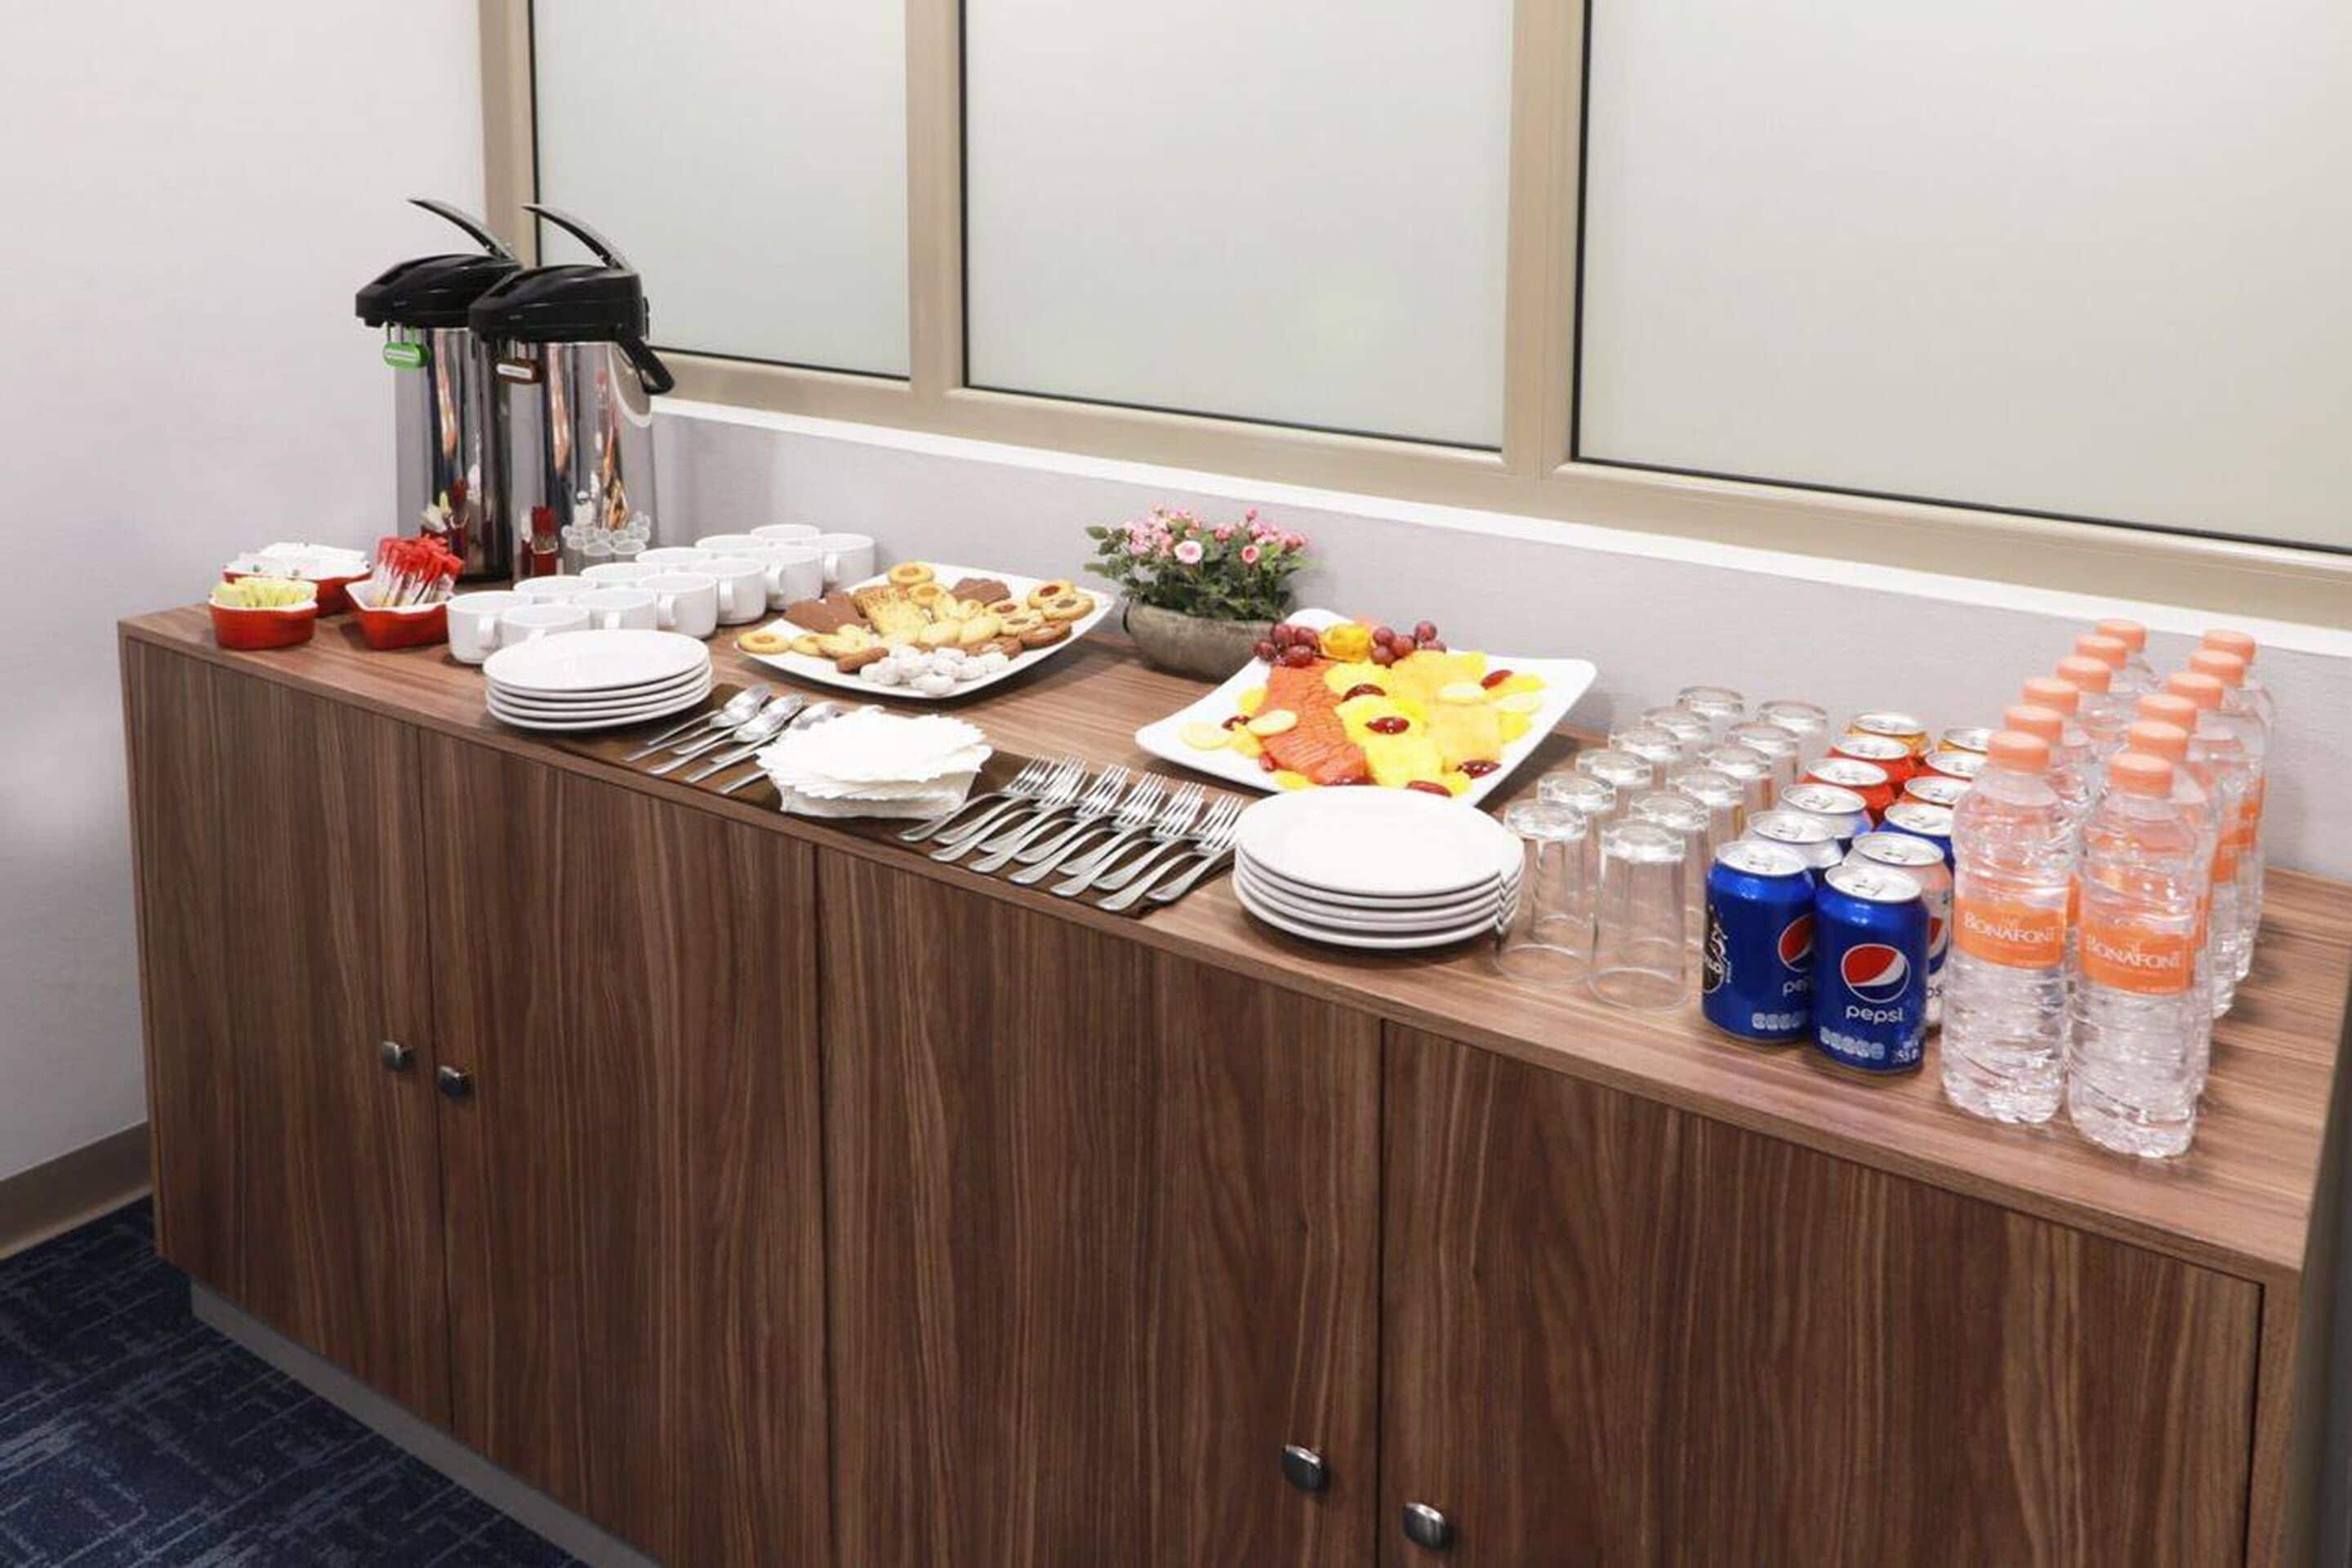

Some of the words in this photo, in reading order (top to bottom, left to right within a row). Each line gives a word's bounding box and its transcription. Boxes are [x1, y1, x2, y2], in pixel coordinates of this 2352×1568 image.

[1964, 911, 2056, 943] BONAFONT
[2086, 933, 2180, 969] BONAFONT
[1846, 1005, 1904, 1025] pepsi
